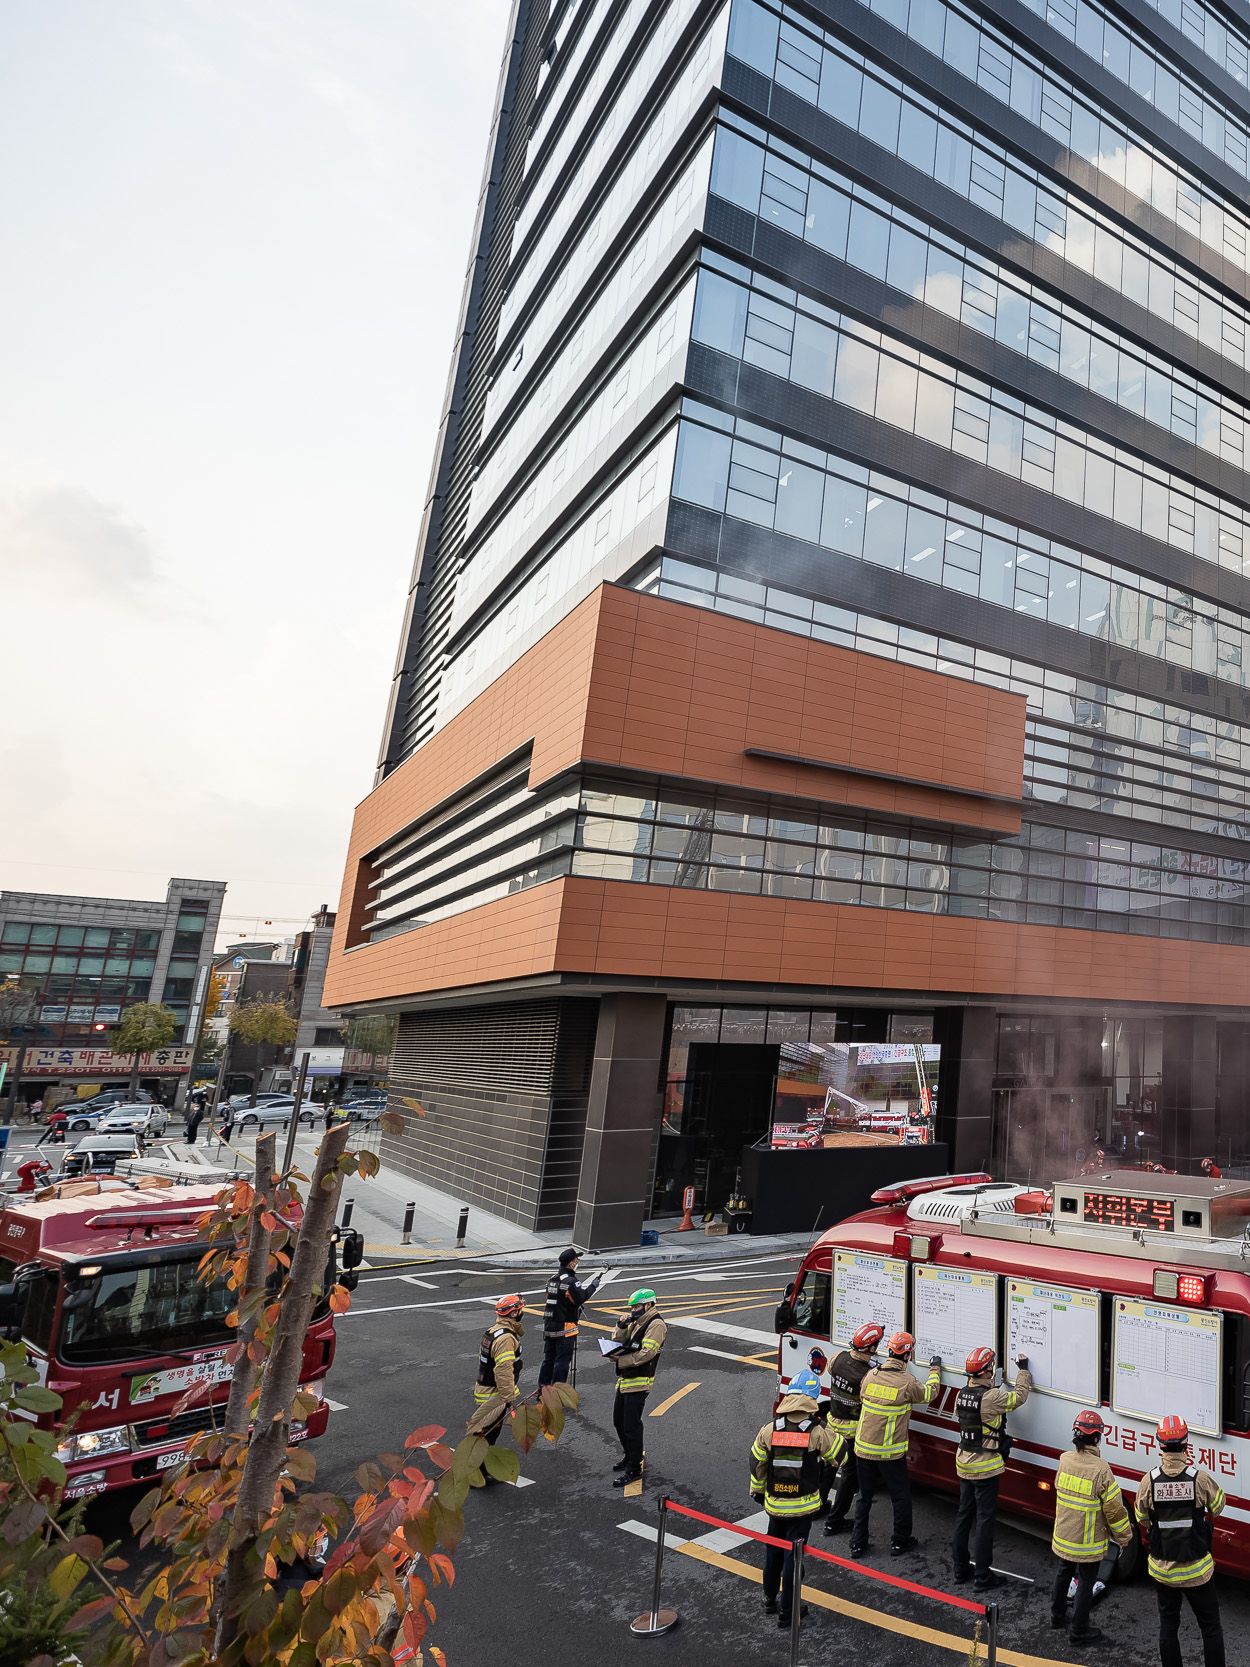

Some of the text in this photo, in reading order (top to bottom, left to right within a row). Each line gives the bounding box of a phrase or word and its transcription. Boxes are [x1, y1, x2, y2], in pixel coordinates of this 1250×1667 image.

[155, 1050, 190, 1066] 총판
[166, 1367, 195, 1381] 생명을
[64, 1482, 109, 1499] 서울소방
[1156, 1488, 1193, 1498] 화재조사
